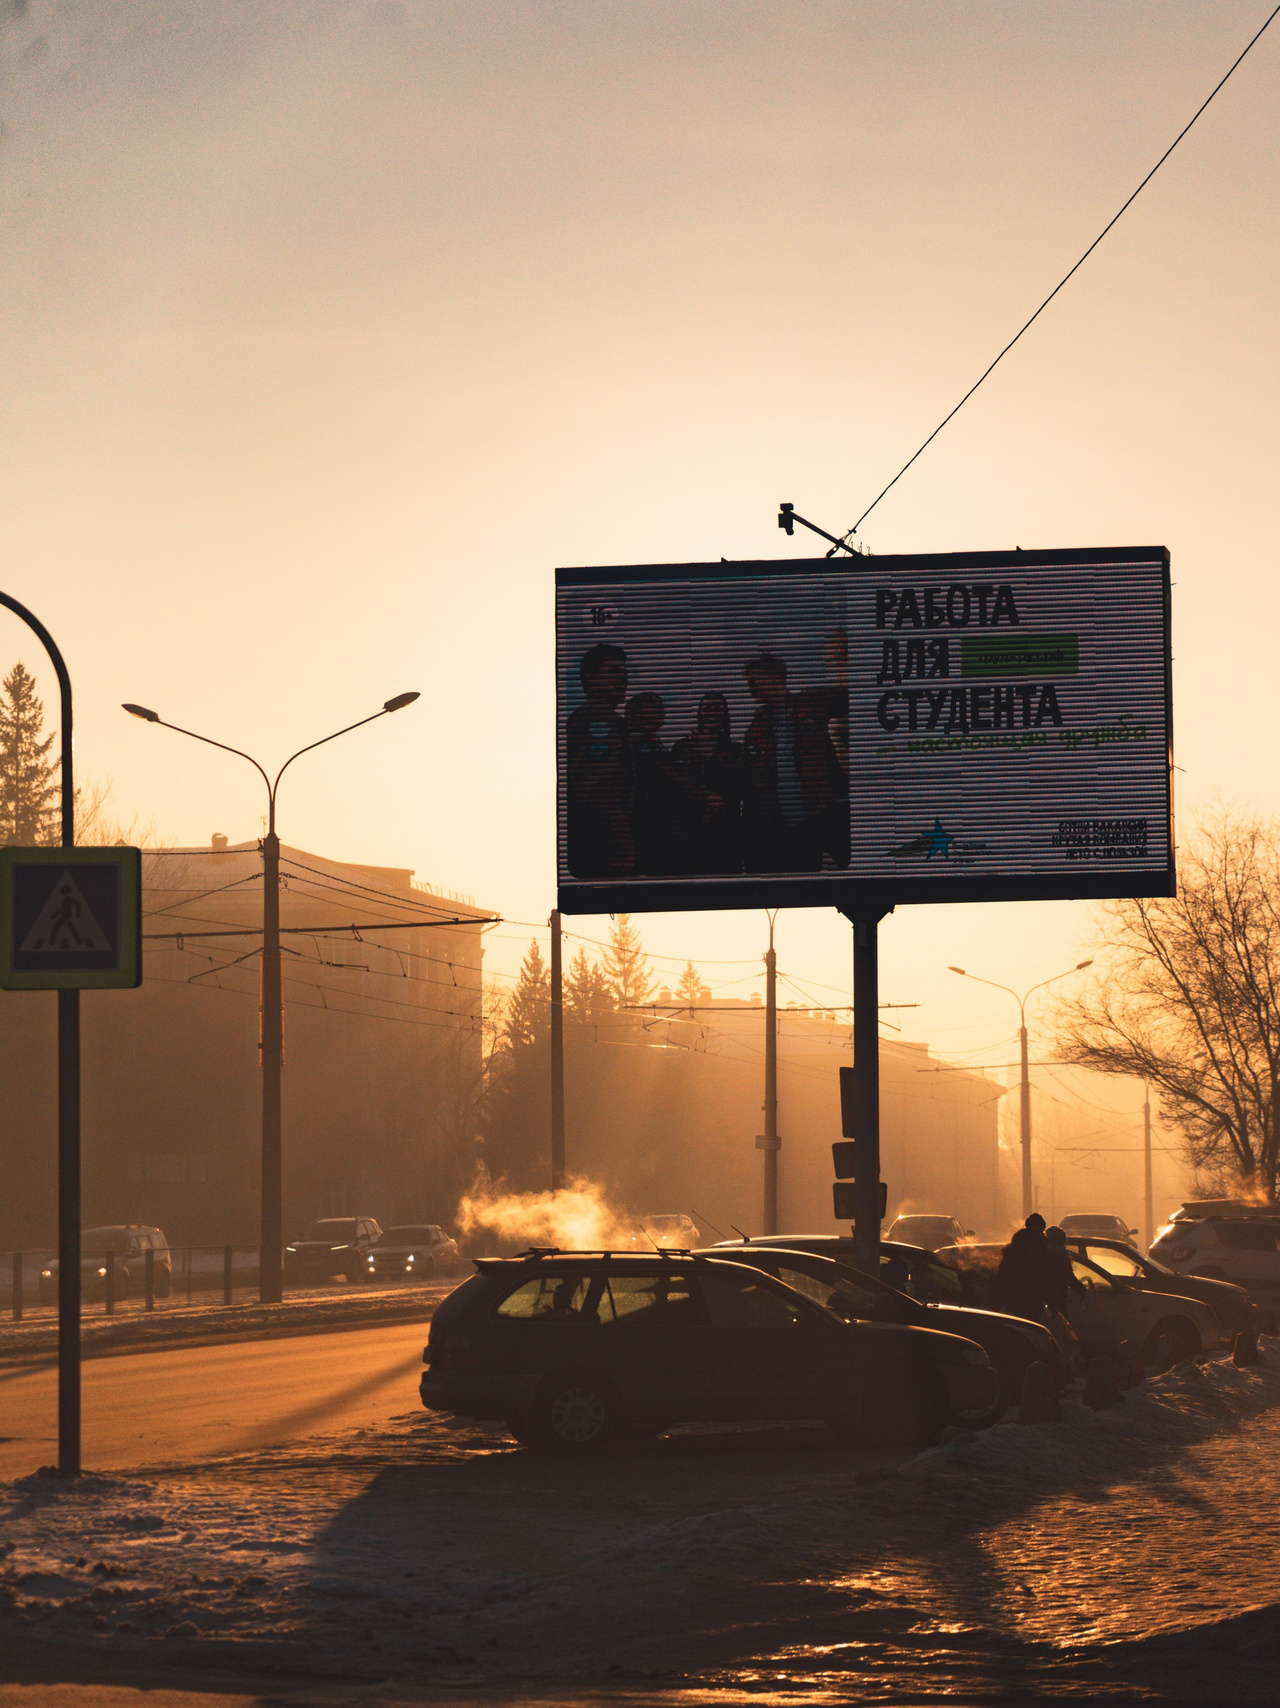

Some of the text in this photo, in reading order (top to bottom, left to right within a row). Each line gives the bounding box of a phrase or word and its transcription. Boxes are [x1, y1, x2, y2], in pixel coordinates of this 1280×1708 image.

[591, 607, 613, 626] 16+
[875, 584, 1020, 630] РАБОТА
[876, 638, 950, 686] ДЛЯ
[875, 685, 1064, 736] СТУДЕНТА
[1051, 832, 1147, 847] КРУТАЯ КОМПАНИЯ
[1065, 848, 1091, 861] ЛЕТО
[1103, 846, 1148, 859] ПОЛЬЗОЙ
